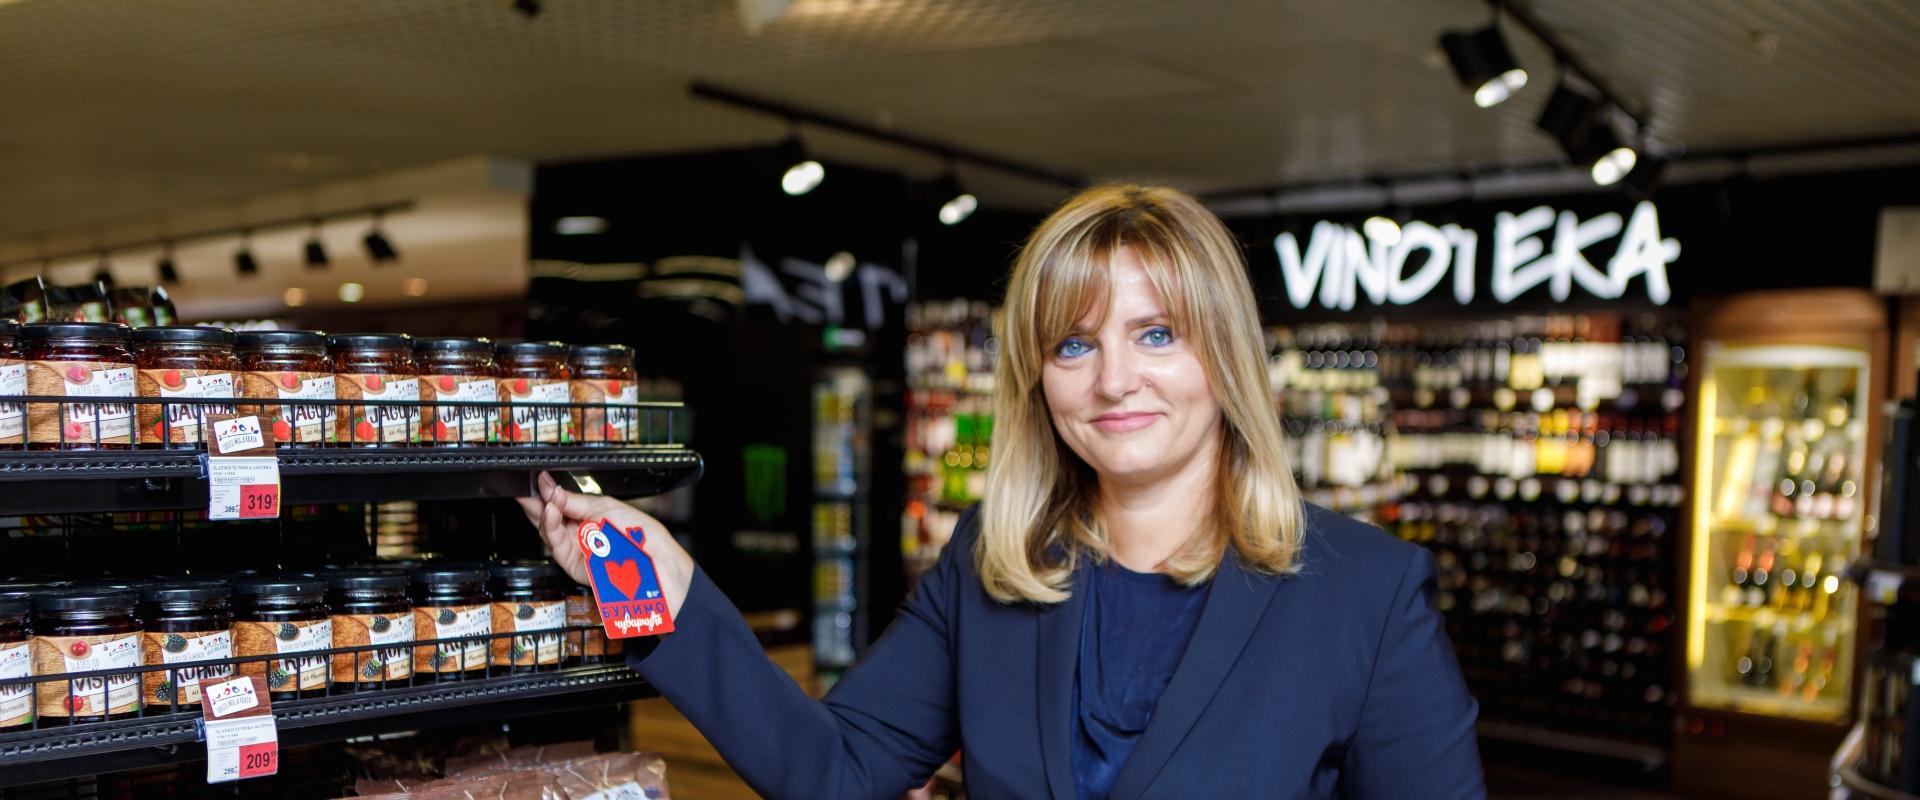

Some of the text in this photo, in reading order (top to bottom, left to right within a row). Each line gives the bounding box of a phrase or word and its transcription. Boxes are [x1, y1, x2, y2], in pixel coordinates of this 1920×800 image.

[73, 391, 133, 419] MLIN
[248, 494, 272, 511] 319
[247, 752, 271, 769] 209
